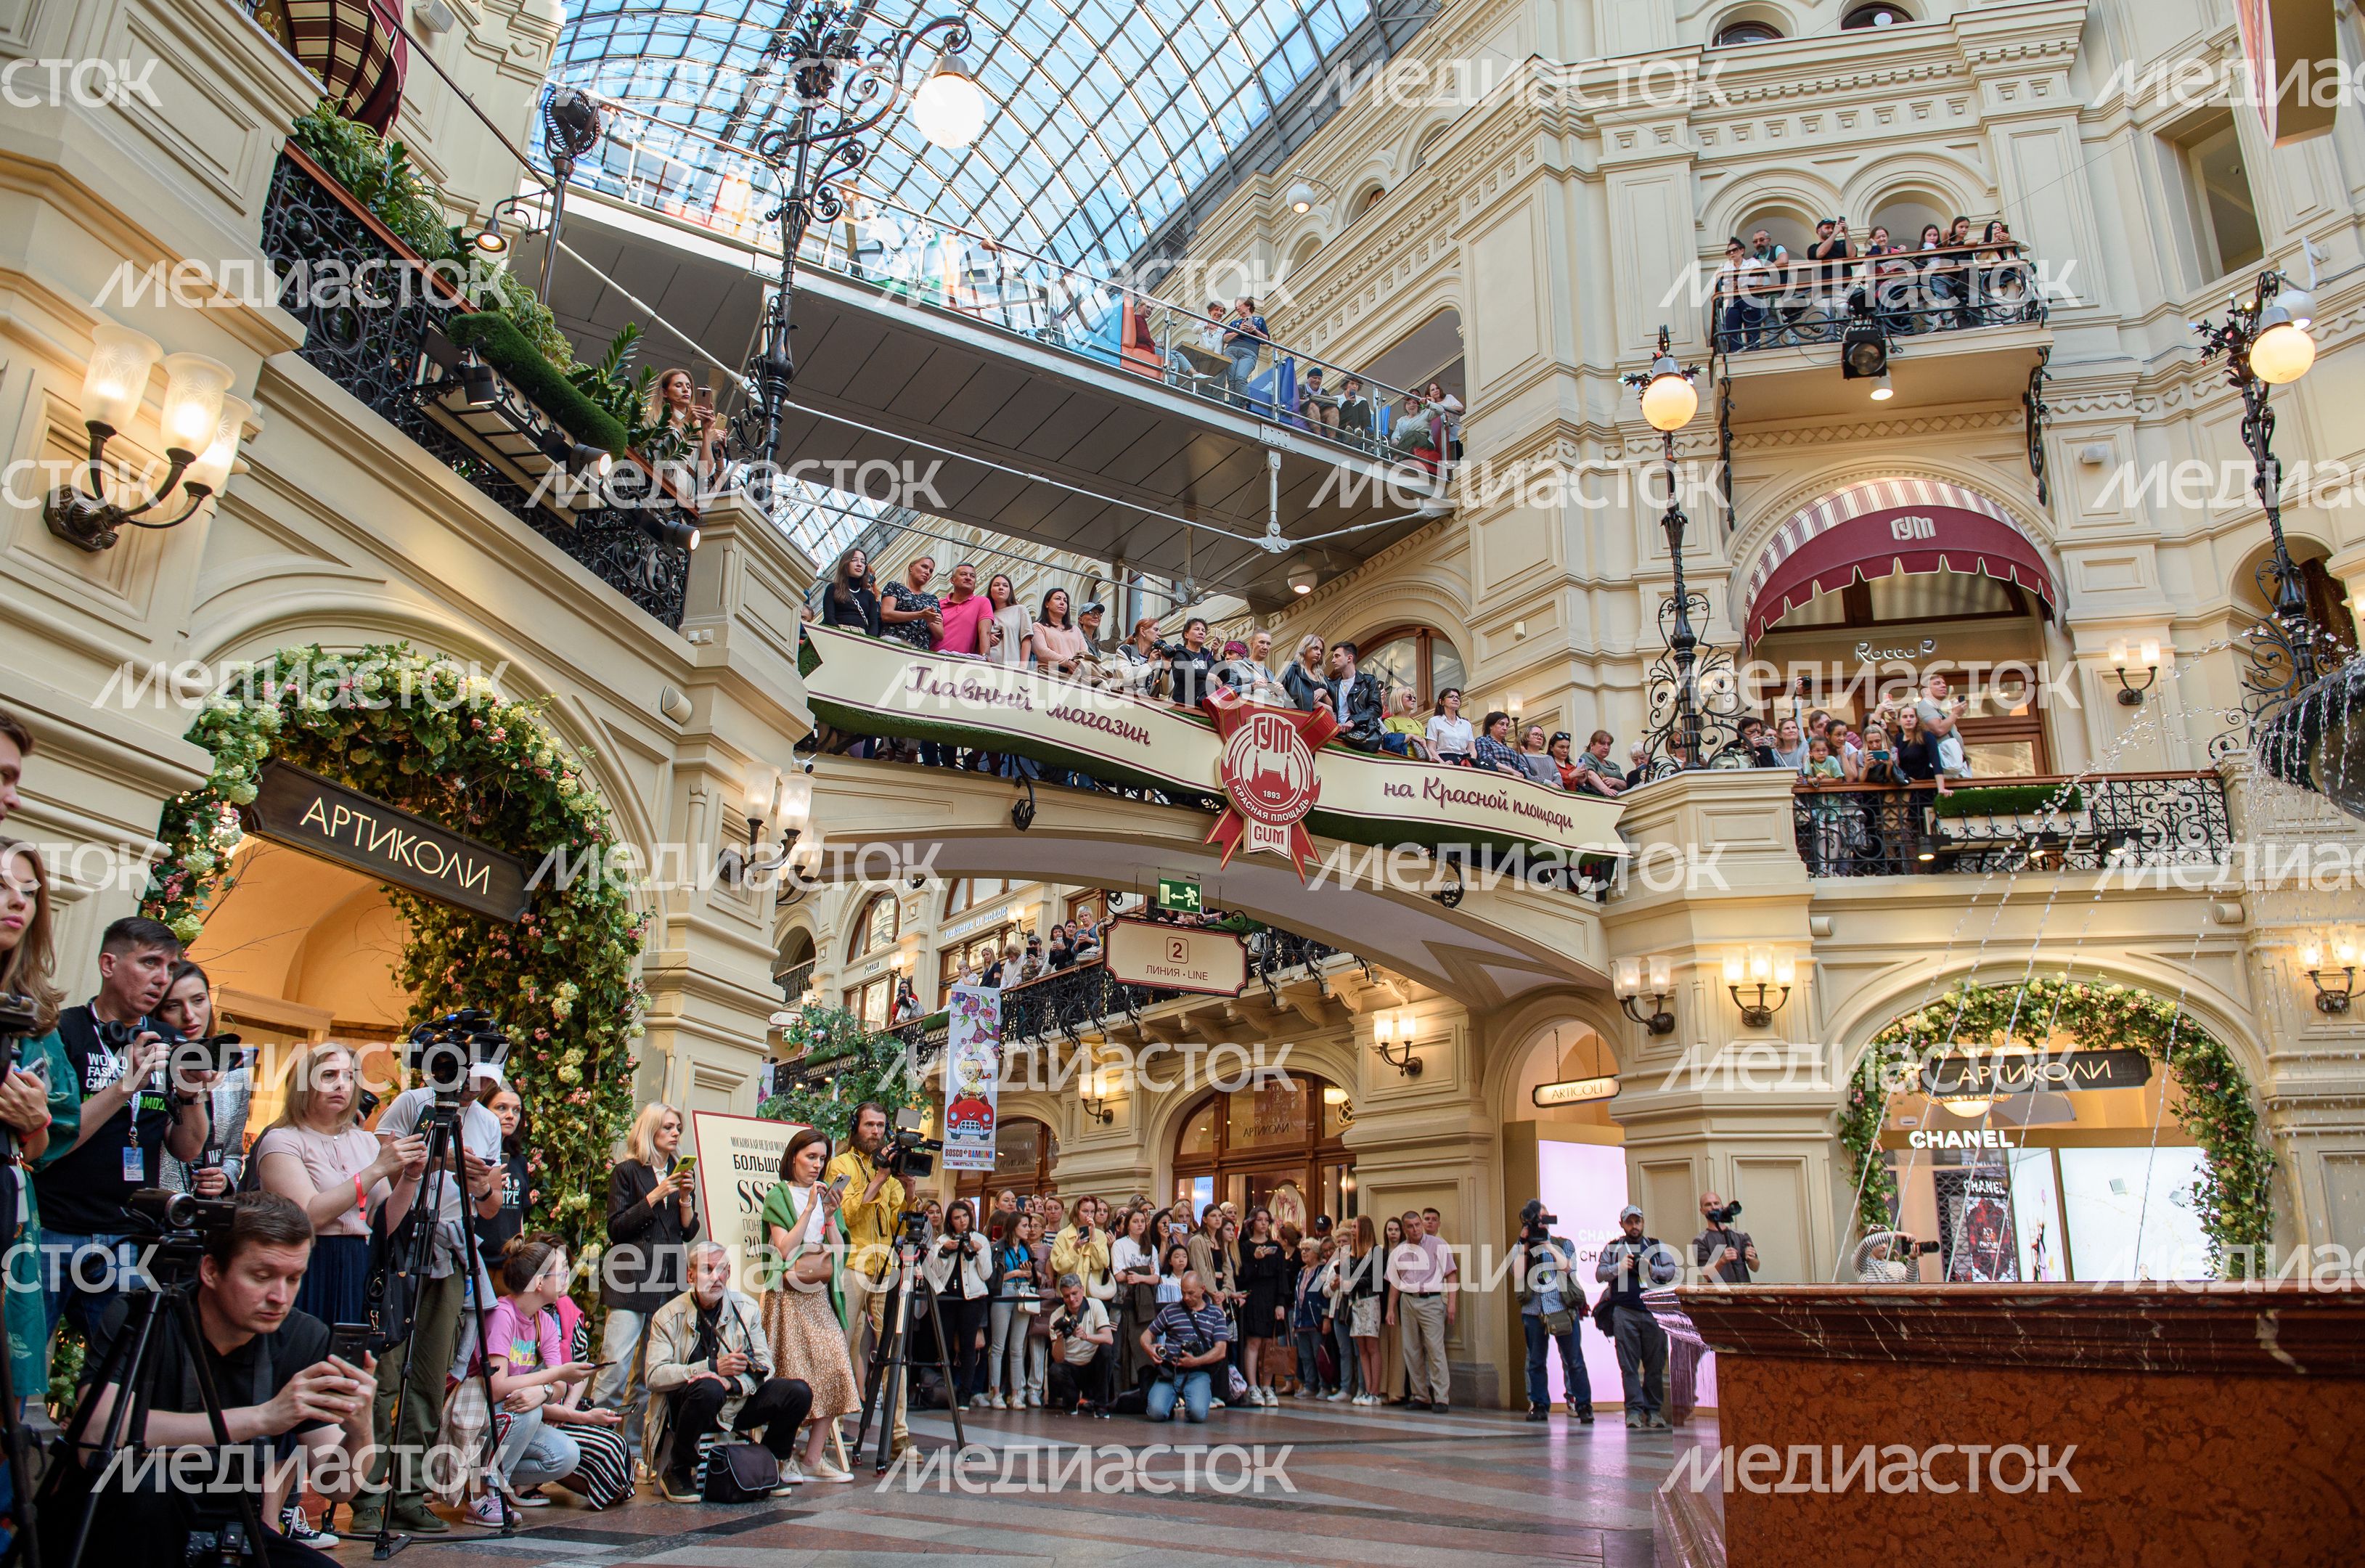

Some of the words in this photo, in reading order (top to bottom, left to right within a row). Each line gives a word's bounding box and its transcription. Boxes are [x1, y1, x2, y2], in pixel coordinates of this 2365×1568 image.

[1856, 642, 1916, 663] Rocco
[906, 666, 1033, 711] Главный
[1047, 703, 1151, 746] магазин
[1234, 785, 1269, 820] КРАСНАЯ
[1270, 798, 1310, 822] ПЛОЩАДЬ
[1263, 790, 1280, 799] 1893
[1384, 782, 1415, 799] на
[1423, 776, 1509, 809] Красной
[1513, 799, 1574, 834] площади
[1254, 825, 1284, 845] GUM
[300, 797, 491, 895] АРТИКОЛИ
[945, 922, 973, 939] PRINCIPE
[975, 918, 983, 927] DI
[1172, 942, 1182, 958] 2
[1146, 965, 1180, 977] ЛИНИЯ
[1188, 970, 1208, 981] LINE
[87, 1053, 128, 1070] WOD
[1958, 1060, 2112, 1086] АРТИКОЛИ
[1551, 1082, 1603, 1100] ARTICOLI
[1243, 1123, 1290, 1138] АРТИКОЛИ
[1908, 1130, 2014, 1148] CHANEL
[730, 1136, 759, 1151] МОСКОВСКАЯ
[945, 1148, 963, 1157] BOSCO
[968, 1150, 993, 1159] BAMBINO
[733, 1154, 781, 1172] БОЛЬШО
[1963, 1179, 2006, 1195] CHANEL
